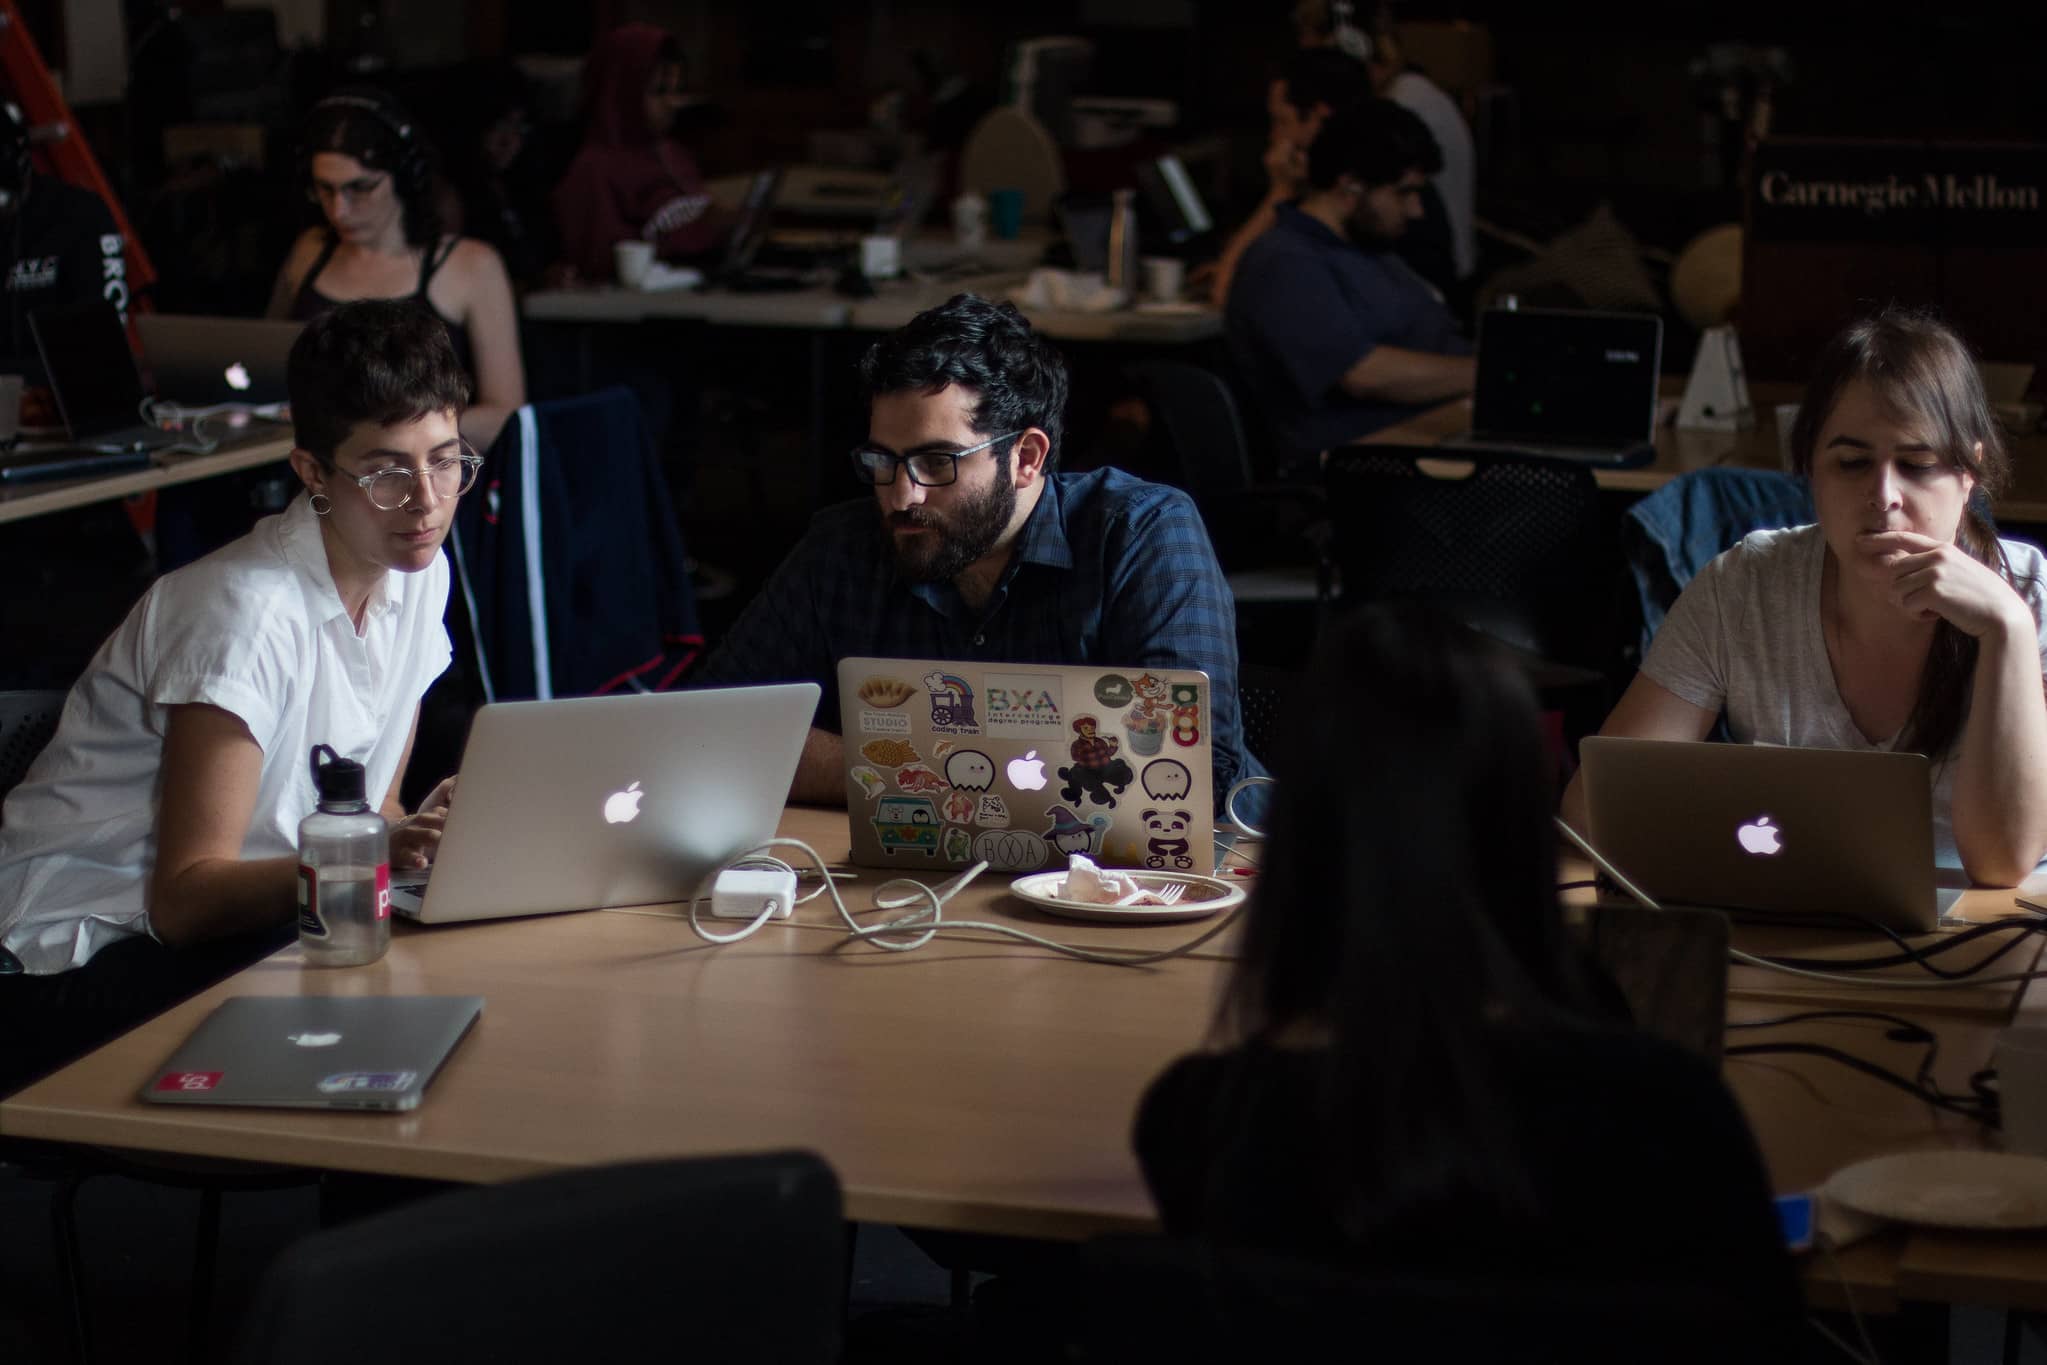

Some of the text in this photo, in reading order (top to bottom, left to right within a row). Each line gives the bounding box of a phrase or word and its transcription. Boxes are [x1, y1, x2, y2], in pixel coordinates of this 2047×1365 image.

[1760, 170, 2040, 217] Carnegie Mellon
[987, 688, 1058, 712] BXA
[864, 717, 907, 727] STUDIO
[932, 726, 957, 734] coding
